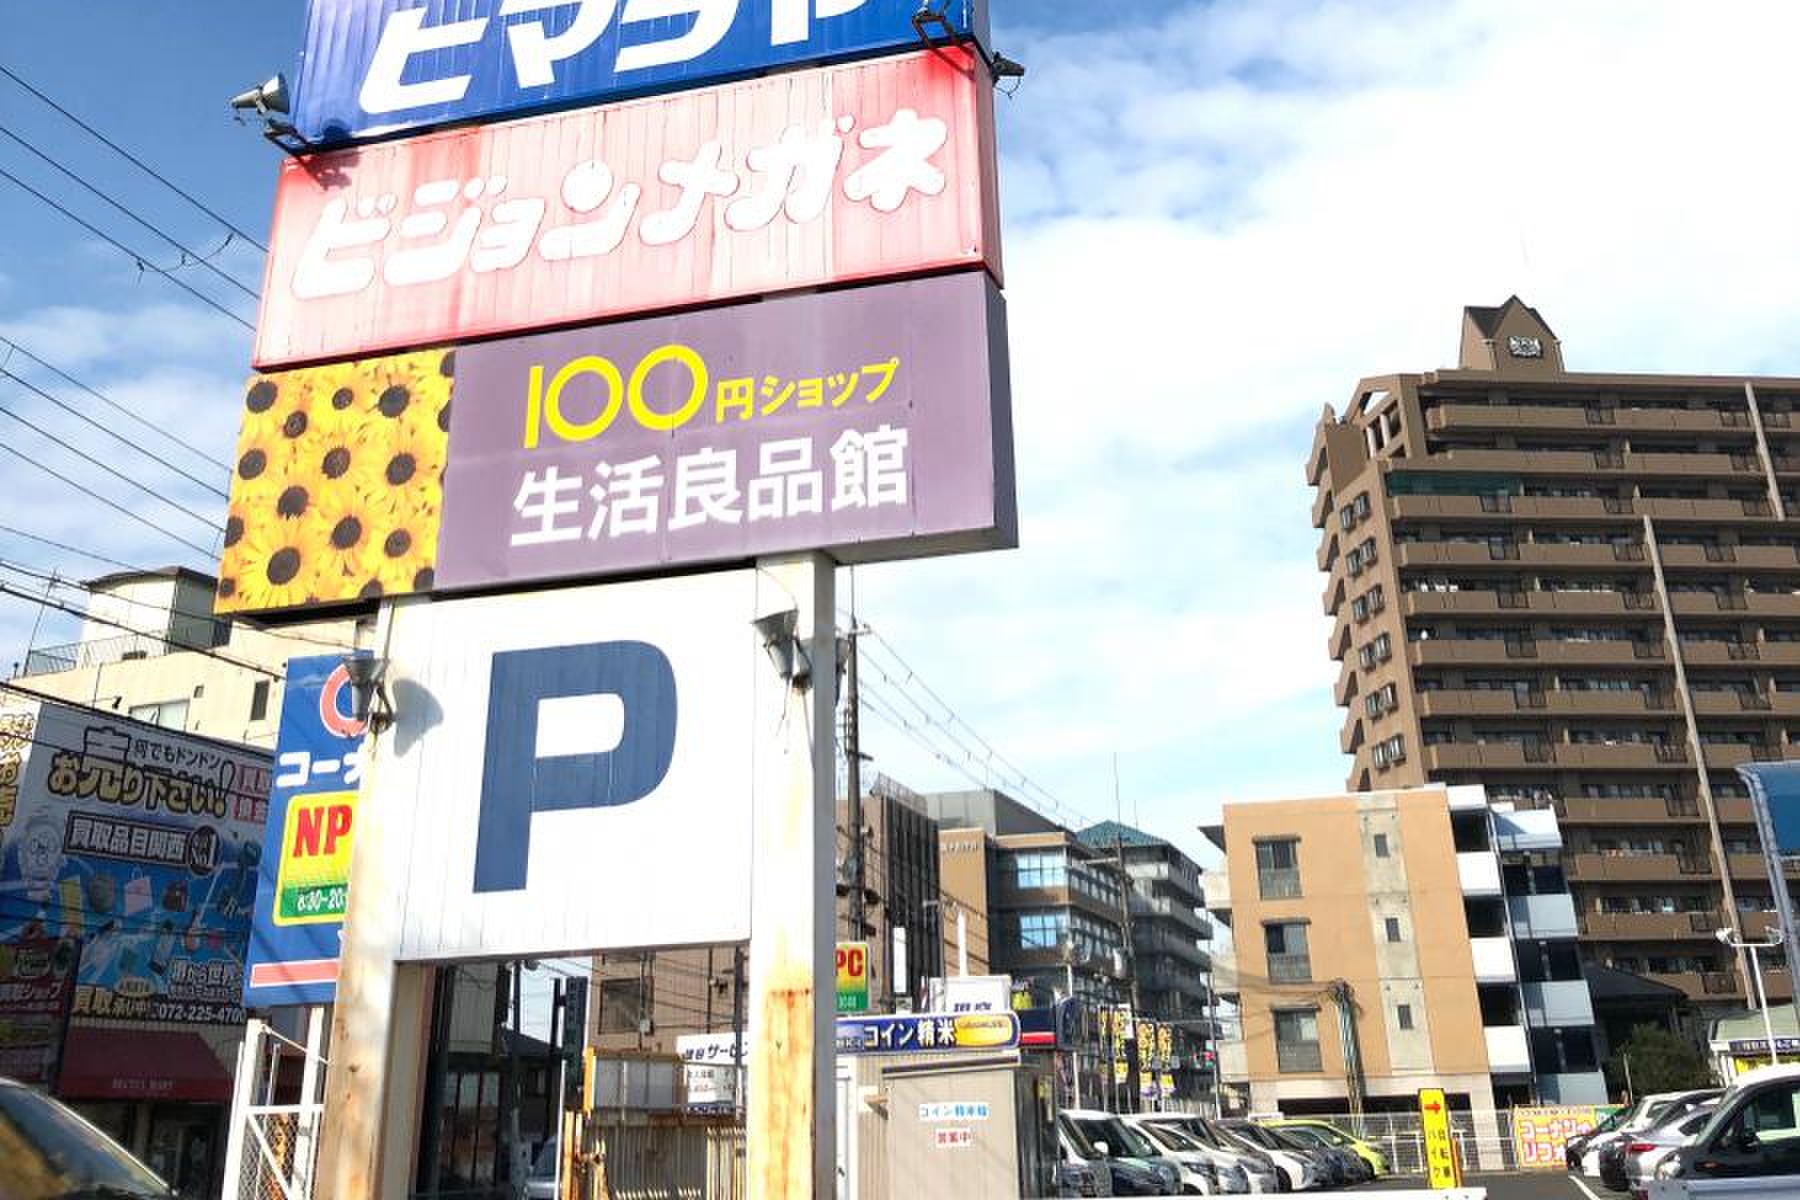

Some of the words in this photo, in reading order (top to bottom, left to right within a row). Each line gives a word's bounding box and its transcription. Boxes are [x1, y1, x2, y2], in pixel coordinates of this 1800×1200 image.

[291, 108, 948, 299] ビジョンメガネ
[523, 344, 900, 449] 100円ショップ
[510, 423, 909, 546] 生活良品館
[474, 639, 677, 893] P
[864, 1018, 955, 1048] コイン精米
